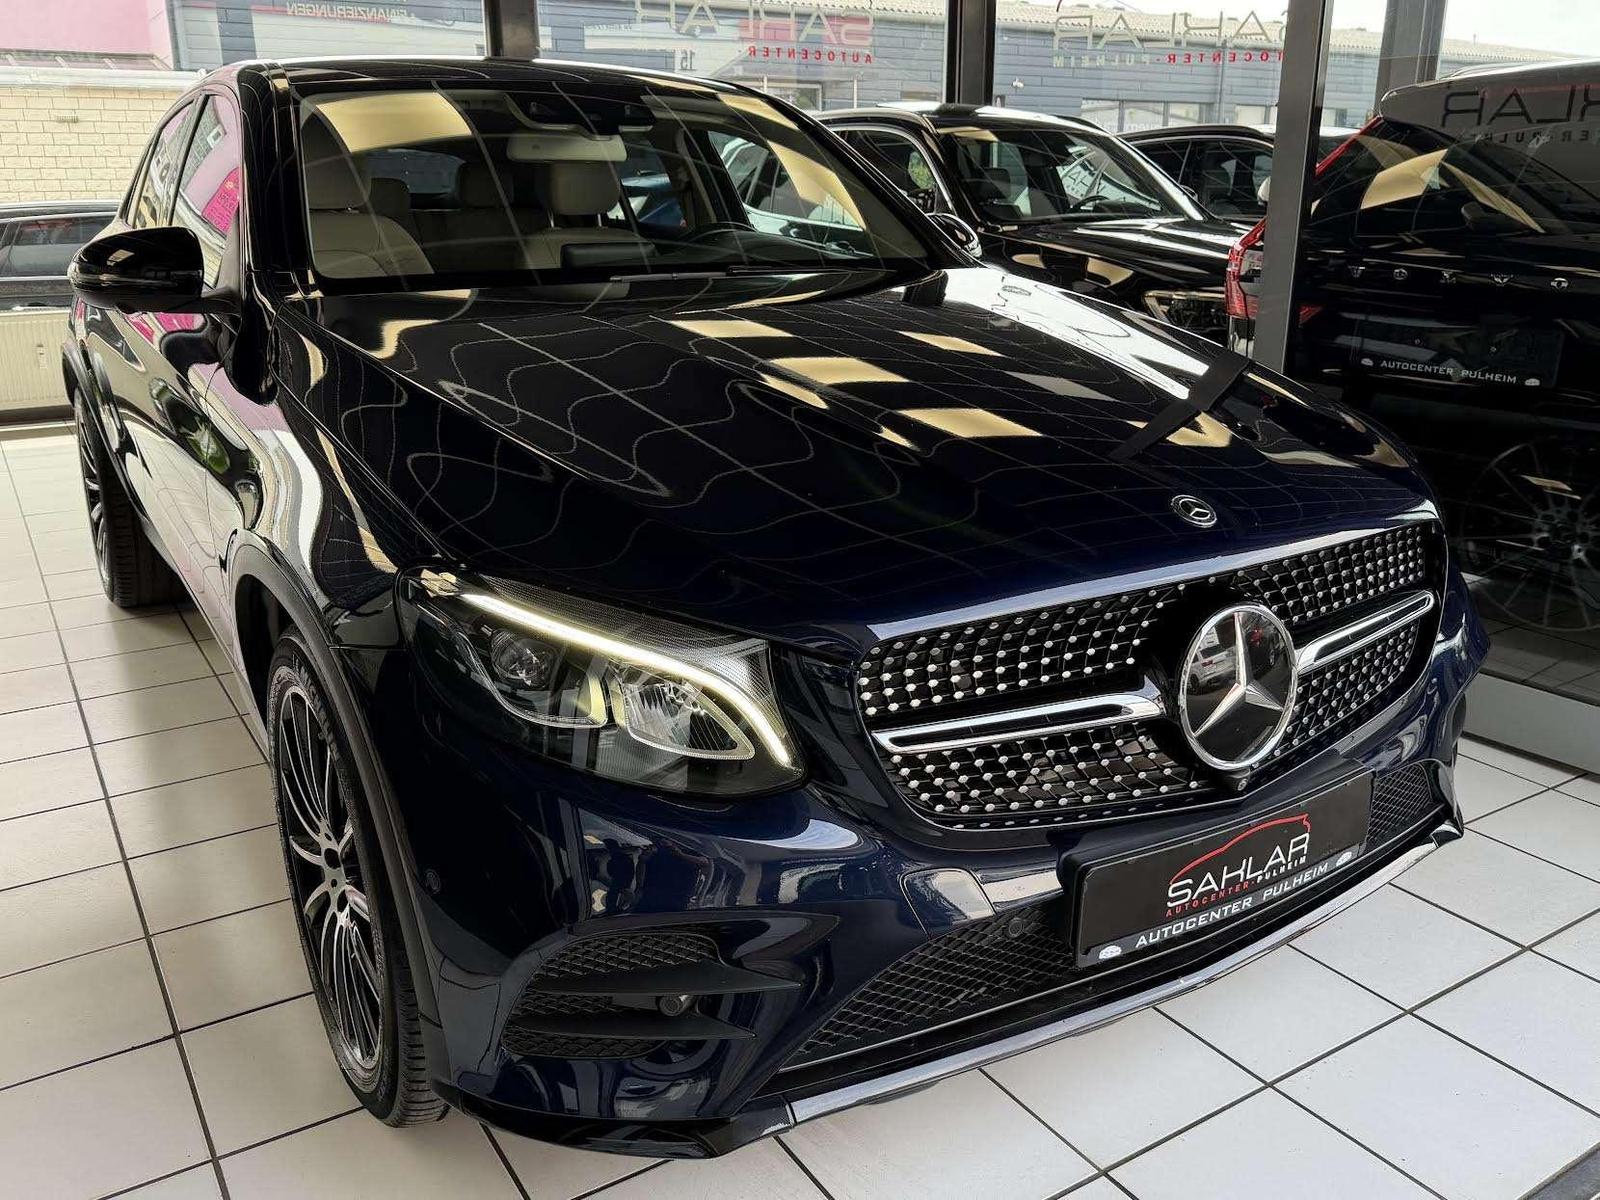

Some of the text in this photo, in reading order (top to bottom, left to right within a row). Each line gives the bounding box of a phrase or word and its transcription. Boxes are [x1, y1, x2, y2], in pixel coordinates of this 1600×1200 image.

[1380, 360, 1517, 384] AUTOCENTER PULHEIM
[1135, 862, 1329, 949] AUTOCENTER PULHEIM
[1166, 833, 1310, 908] SAHLAR
